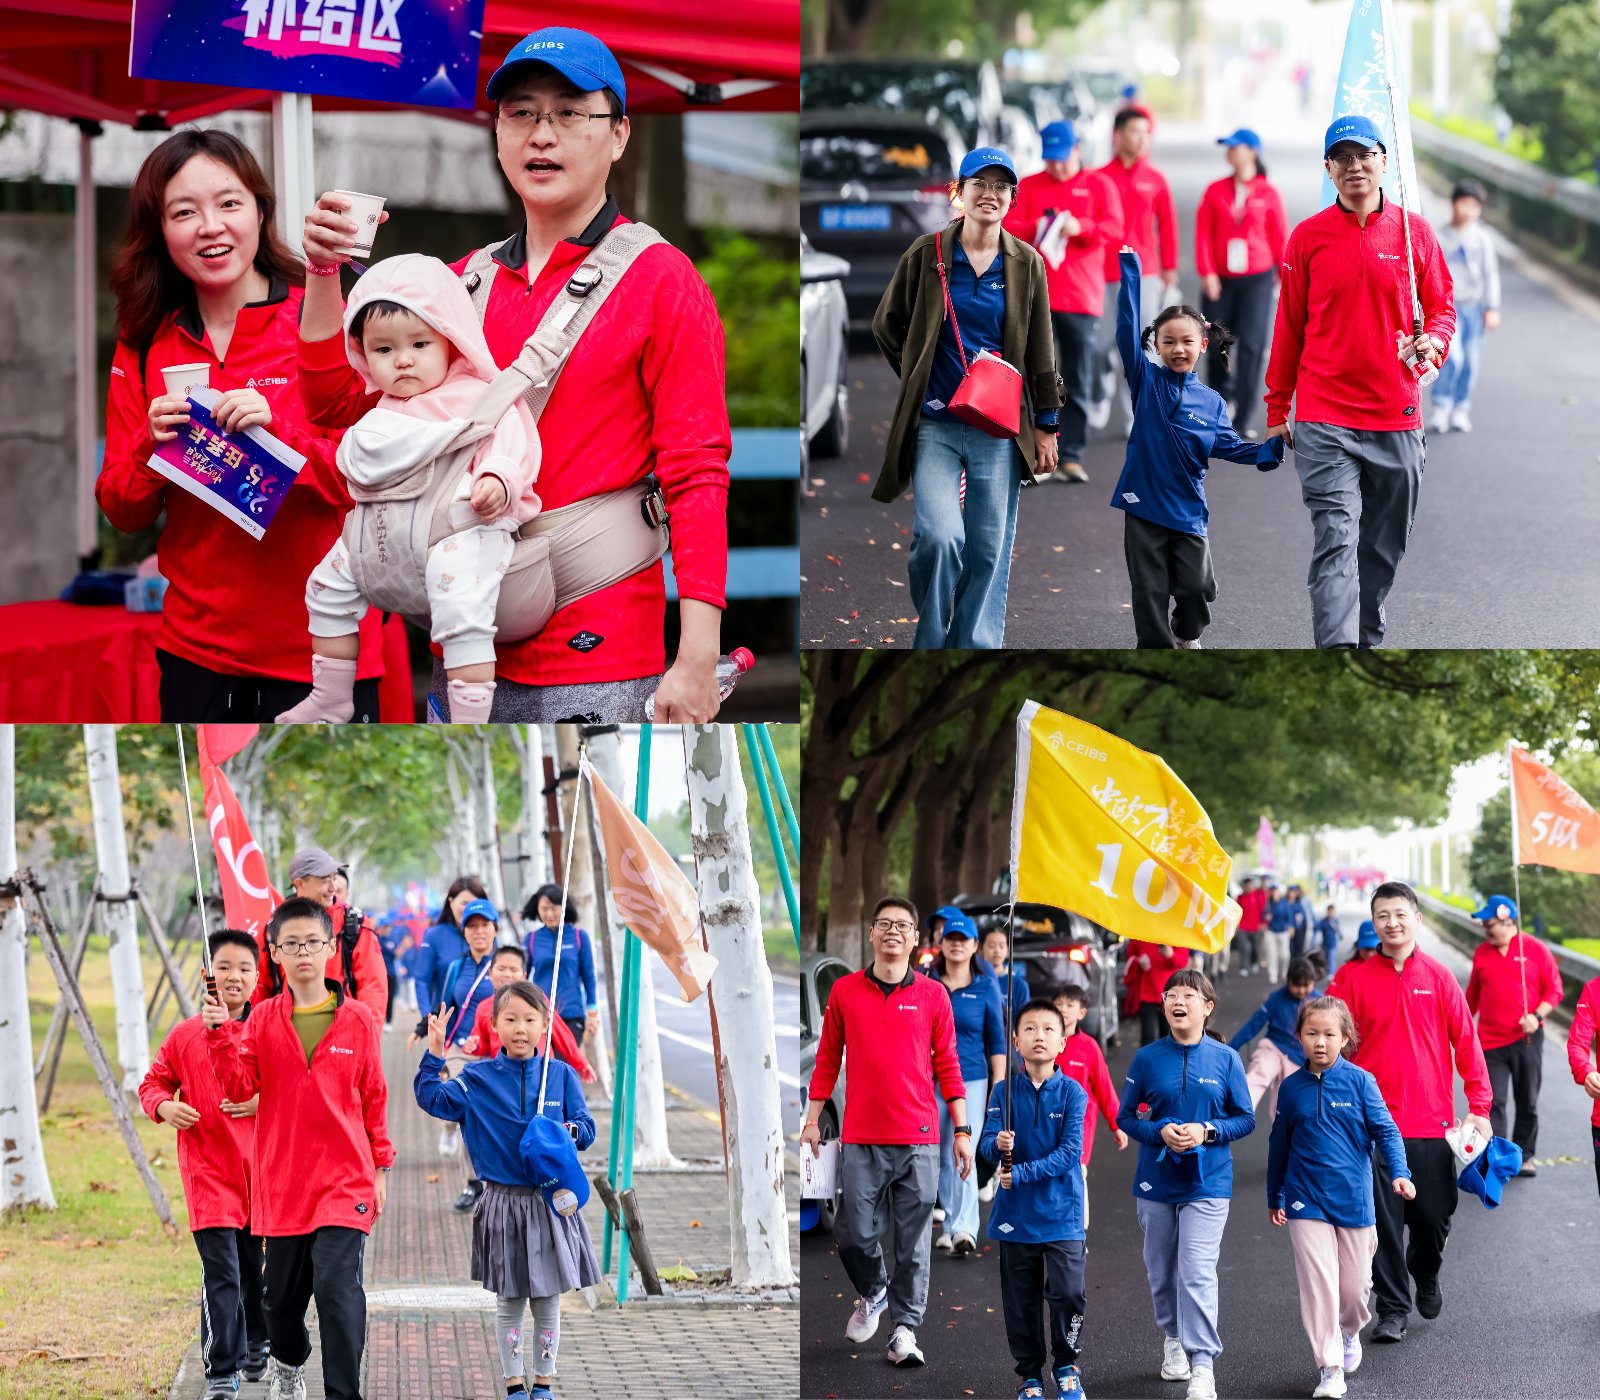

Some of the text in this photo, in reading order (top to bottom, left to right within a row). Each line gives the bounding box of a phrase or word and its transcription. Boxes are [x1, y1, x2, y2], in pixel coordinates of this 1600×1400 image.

[525, 41, 565, 53] CEIBS
[257, 377, 288, 387] CEIBS
[187, 424, 244, 470] 任务卡
[1066, 740, 1108, 763] CEIBS
[1531, 810, 1581, 851] 5队
